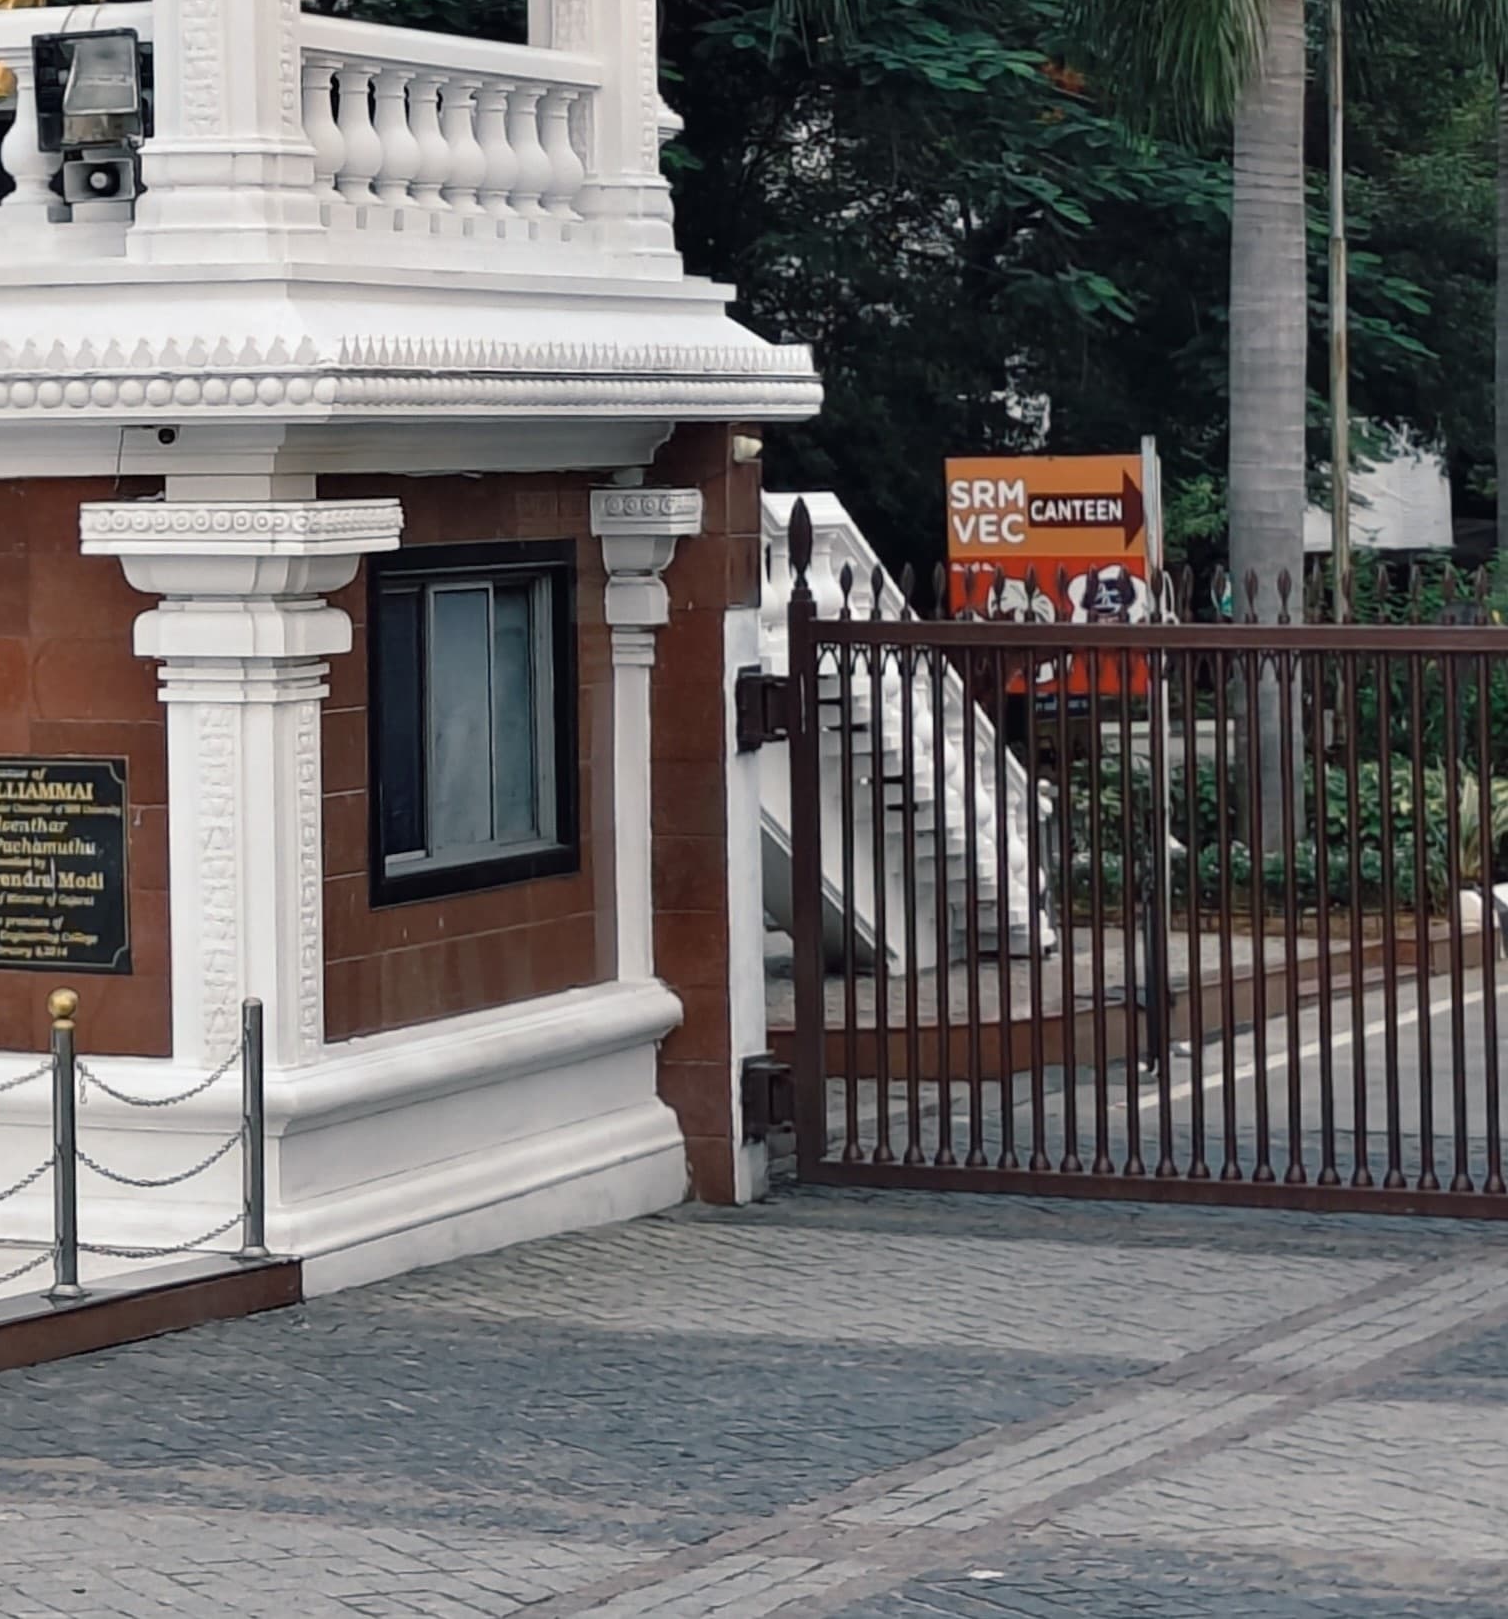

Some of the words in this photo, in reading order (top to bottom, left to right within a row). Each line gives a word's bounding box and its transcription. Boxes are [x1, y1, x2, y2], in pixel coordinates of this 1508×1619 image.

[950, 479, 1025, 509] SRM
[1030, 499, 1122, 521] CANTEEN
[953, 514, 1025, 543] VEC
[58, 871, 104, 890] Modi
